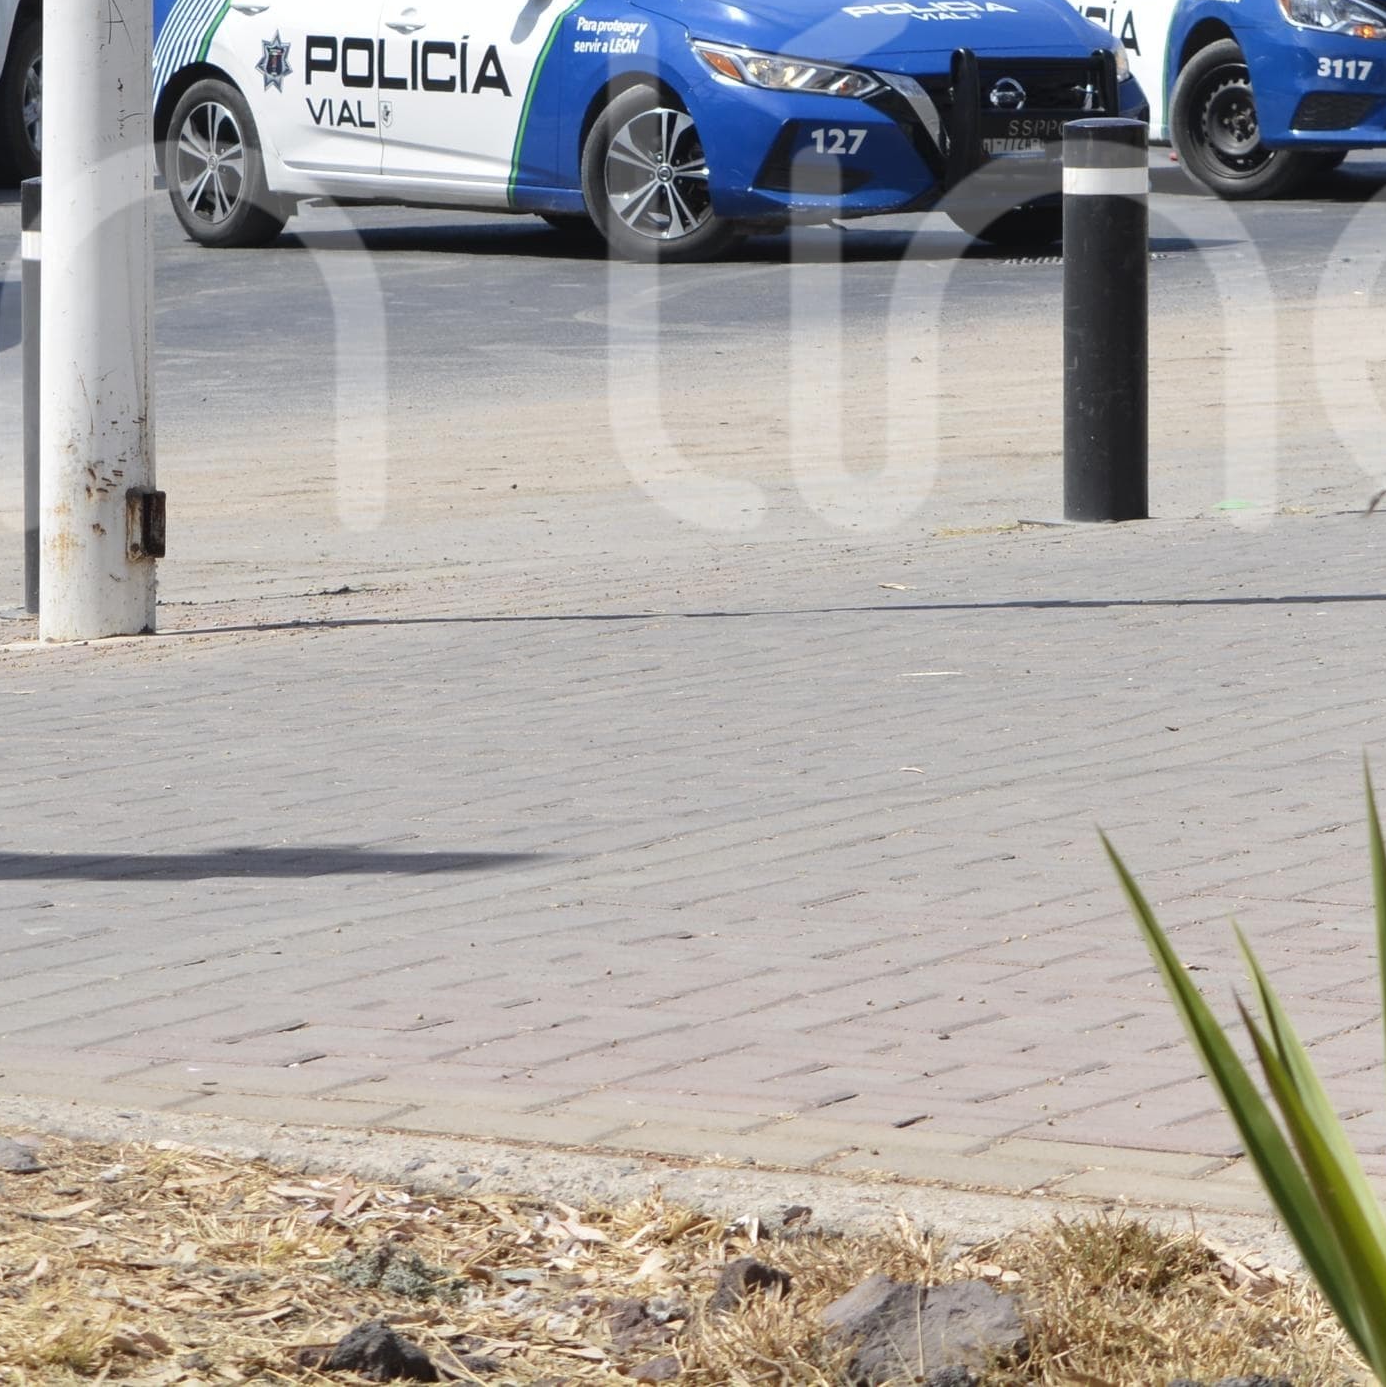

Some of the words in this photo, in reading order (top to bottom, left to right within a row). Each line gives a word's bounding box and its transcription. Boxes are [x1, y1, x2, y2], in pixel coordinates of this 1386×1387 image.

[577, 16, 598, 32] Para
[597, 19, 637, 37] proteger
[637, 22, 648, 37] y
[573, 39, 601, 53] servir
[601, 43, 608, 53] a
[608, 38, 640, 54] LEÓN
[305, 35, 513, 97] POLICÍA
[1317, 57, 1373, 81] 3117
[305, 97, 376, 129] VIAL
[810, 128, 868, 155] 127
